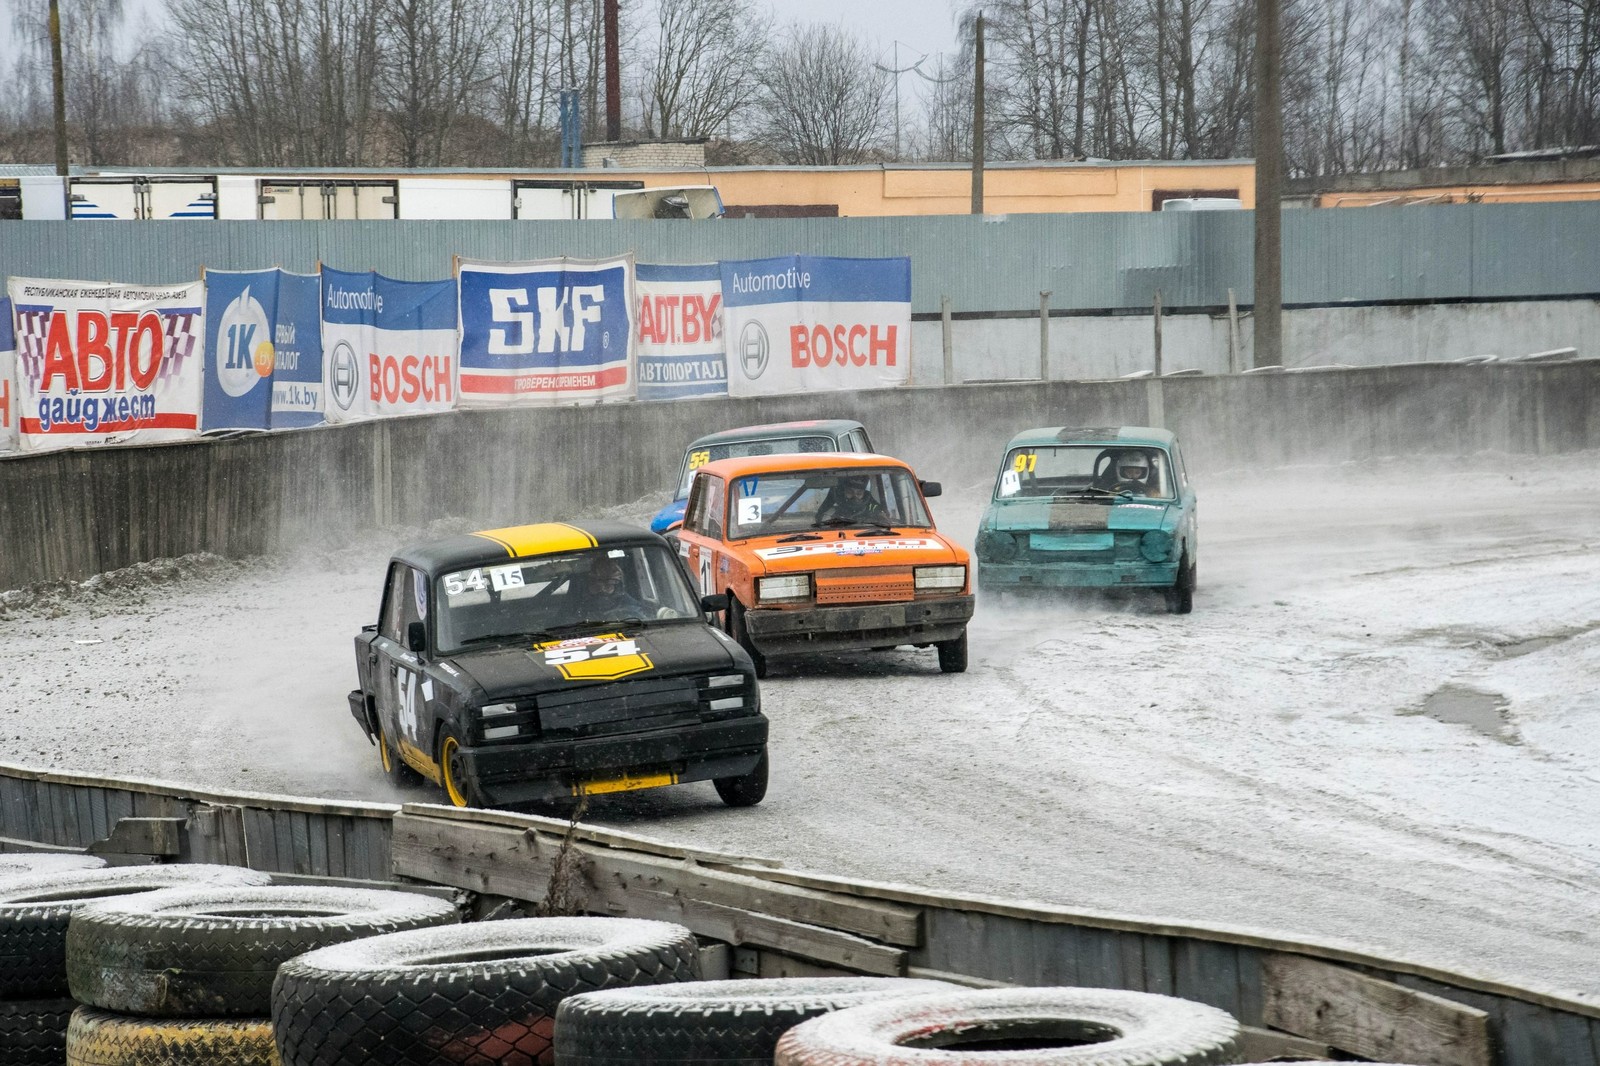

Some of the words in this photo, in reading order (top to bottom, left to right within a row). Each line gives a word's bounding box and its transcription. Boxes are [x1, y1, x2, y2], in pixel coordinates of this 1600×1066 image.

[733, 267, 811, 293] Automotive
[327, 284, 383, 314] Automotive
[488, 284, 605, 355] SKF
[39, 310, 164, 393] АВТО
[225, 324, 257, 369] 1K
[790, 324, 897, 368] BOSCH
[369, 353, 452, 404] BOSCH
[640, 360, 725, 381] АВТОПОРТАЛ
[689, 452, 710, 470] 55
[1014, 454, 1037, 473] 97
[739, 477, 759, 496] 17
[747, 504, 760, 521] 3
[443, 568, 487, 595] 54
[500, 570, 522, 585] 15
[545, 640, 641, 665] 54
[397, 666, 418, 741] 54
